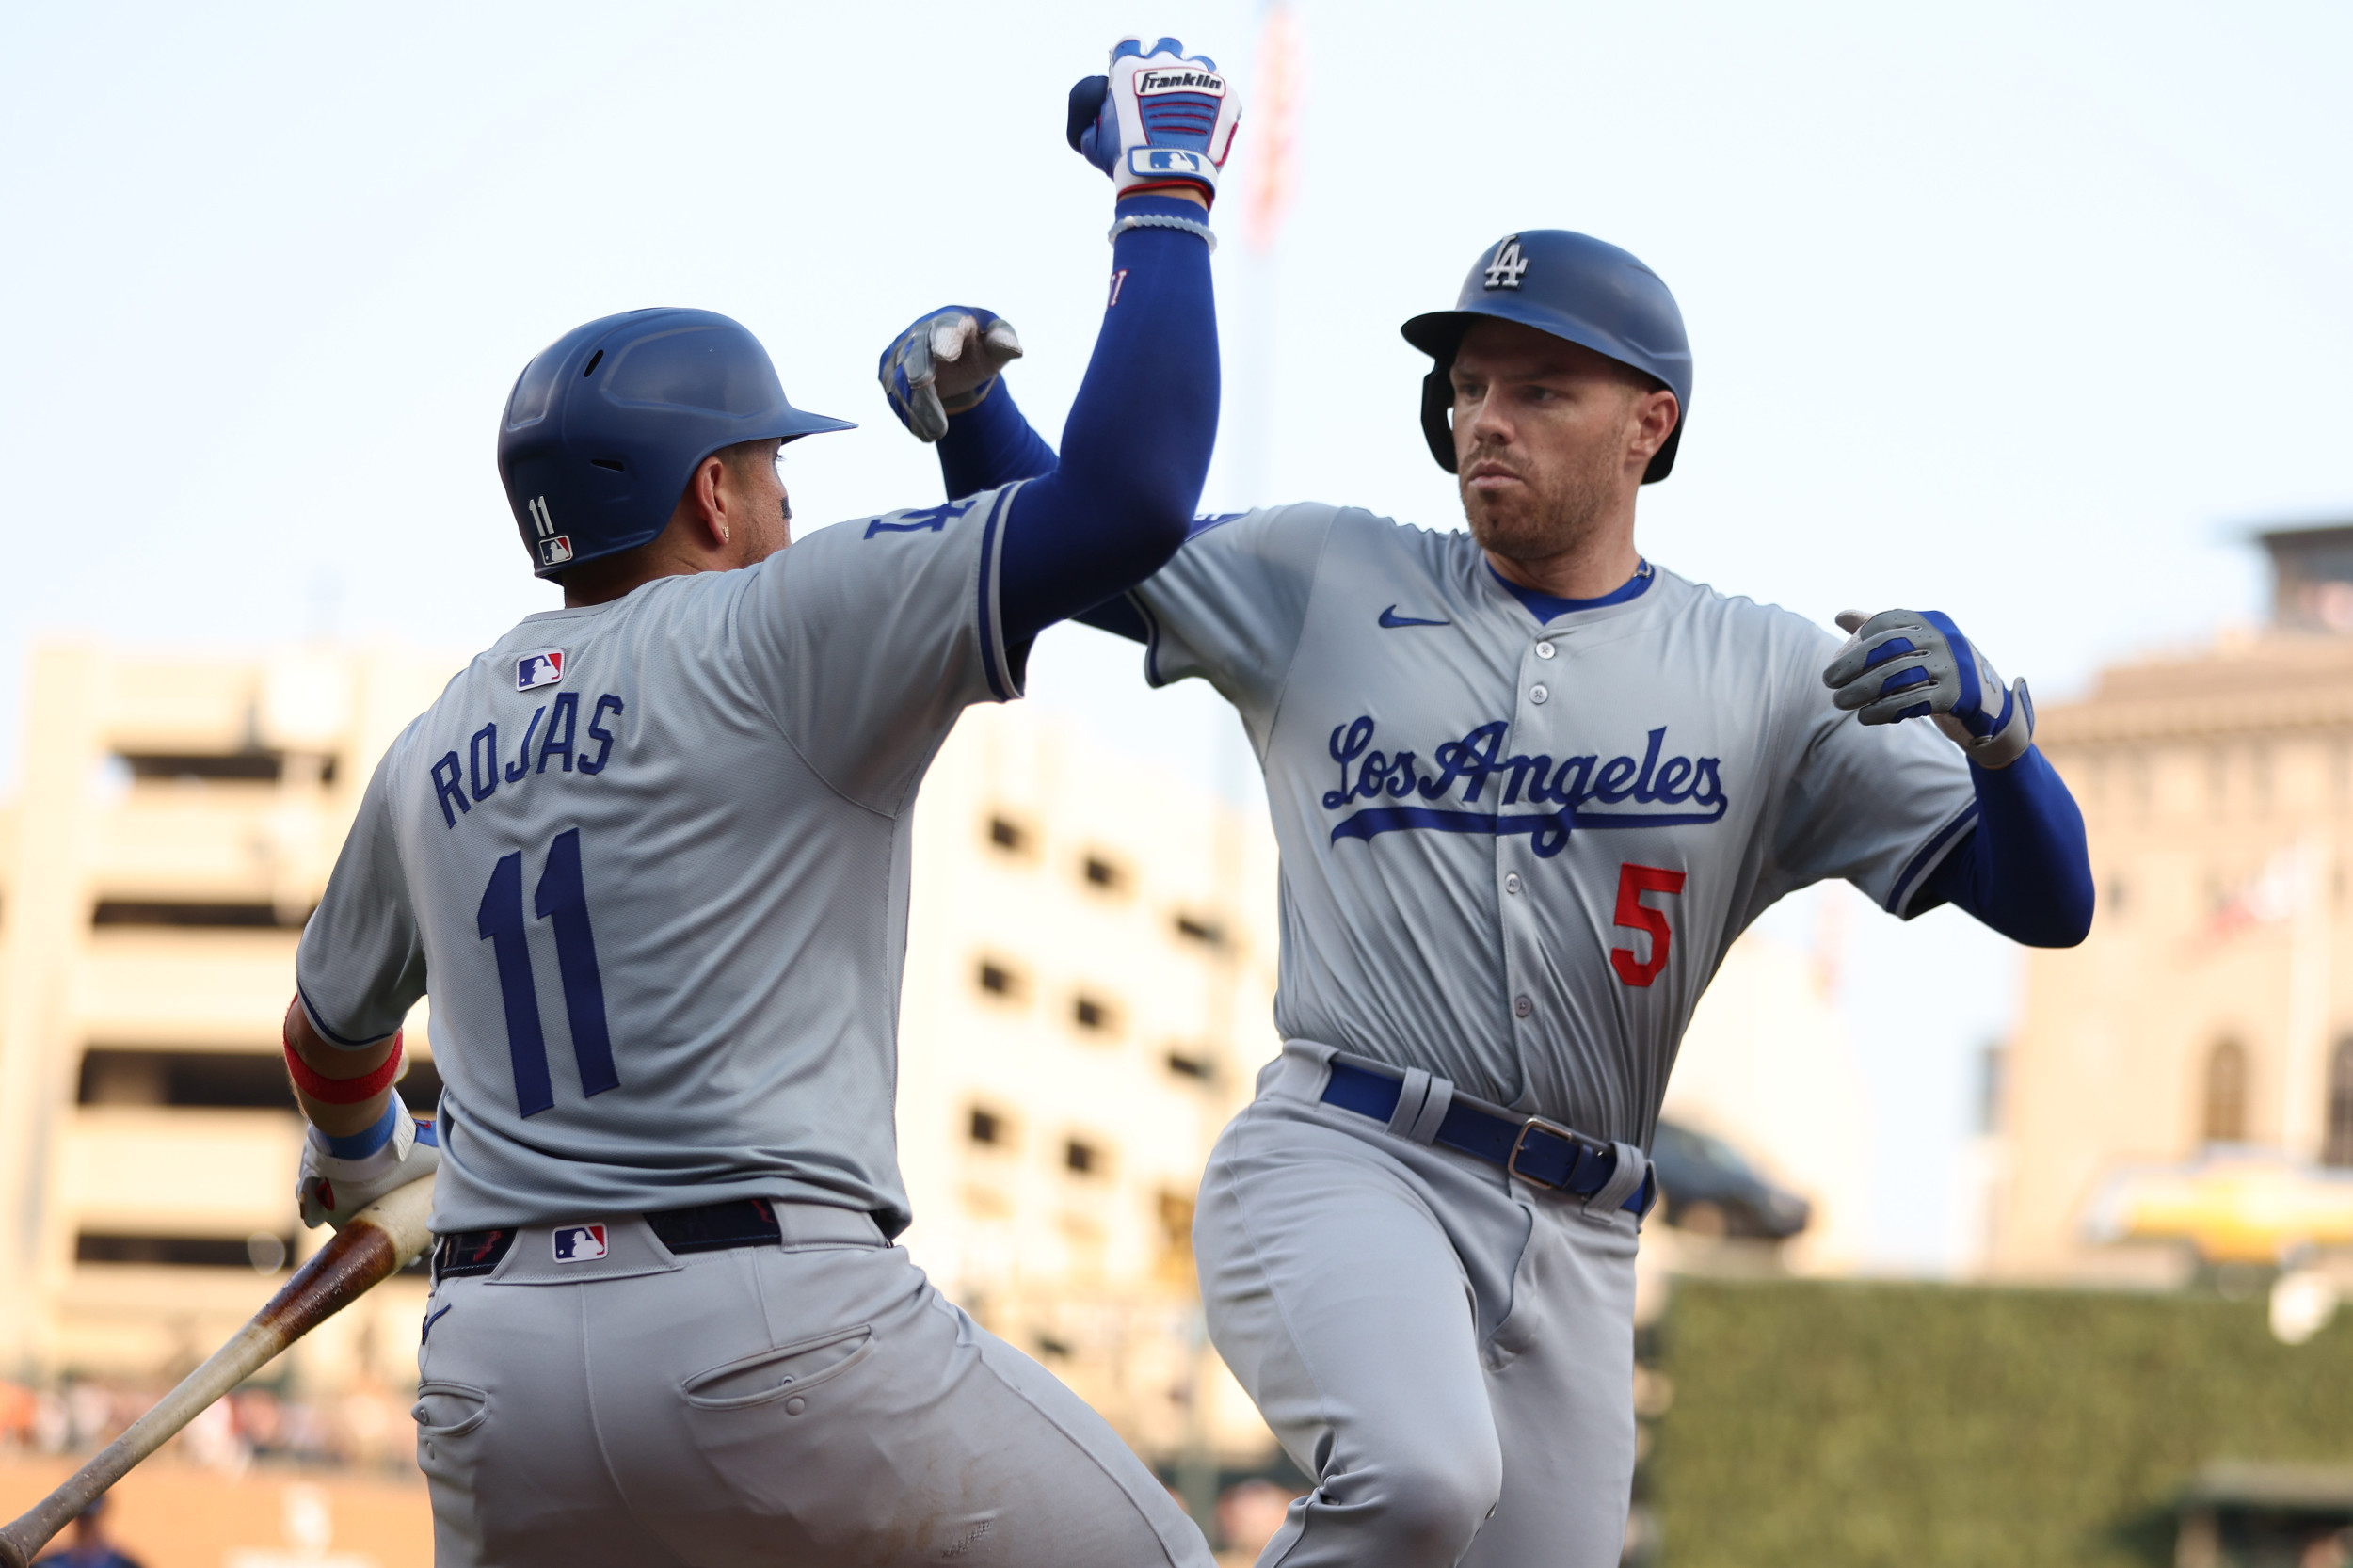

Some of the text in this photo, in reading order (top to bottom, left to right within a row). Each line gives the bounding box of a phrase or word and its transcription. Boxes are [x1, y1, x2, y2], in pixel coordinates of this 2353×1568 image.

[1140, 72, 1222, 92] Franklin
[1484, 235, 1529, 287] LA
[529, 496, 554, 537] 11
[430, 692, 624, 829] ROJAS
[1322, 716, 1728, 858] Los Angeles
[477, 827, 620, 1119] 11
[1610, 862, 1686, 987] 5
